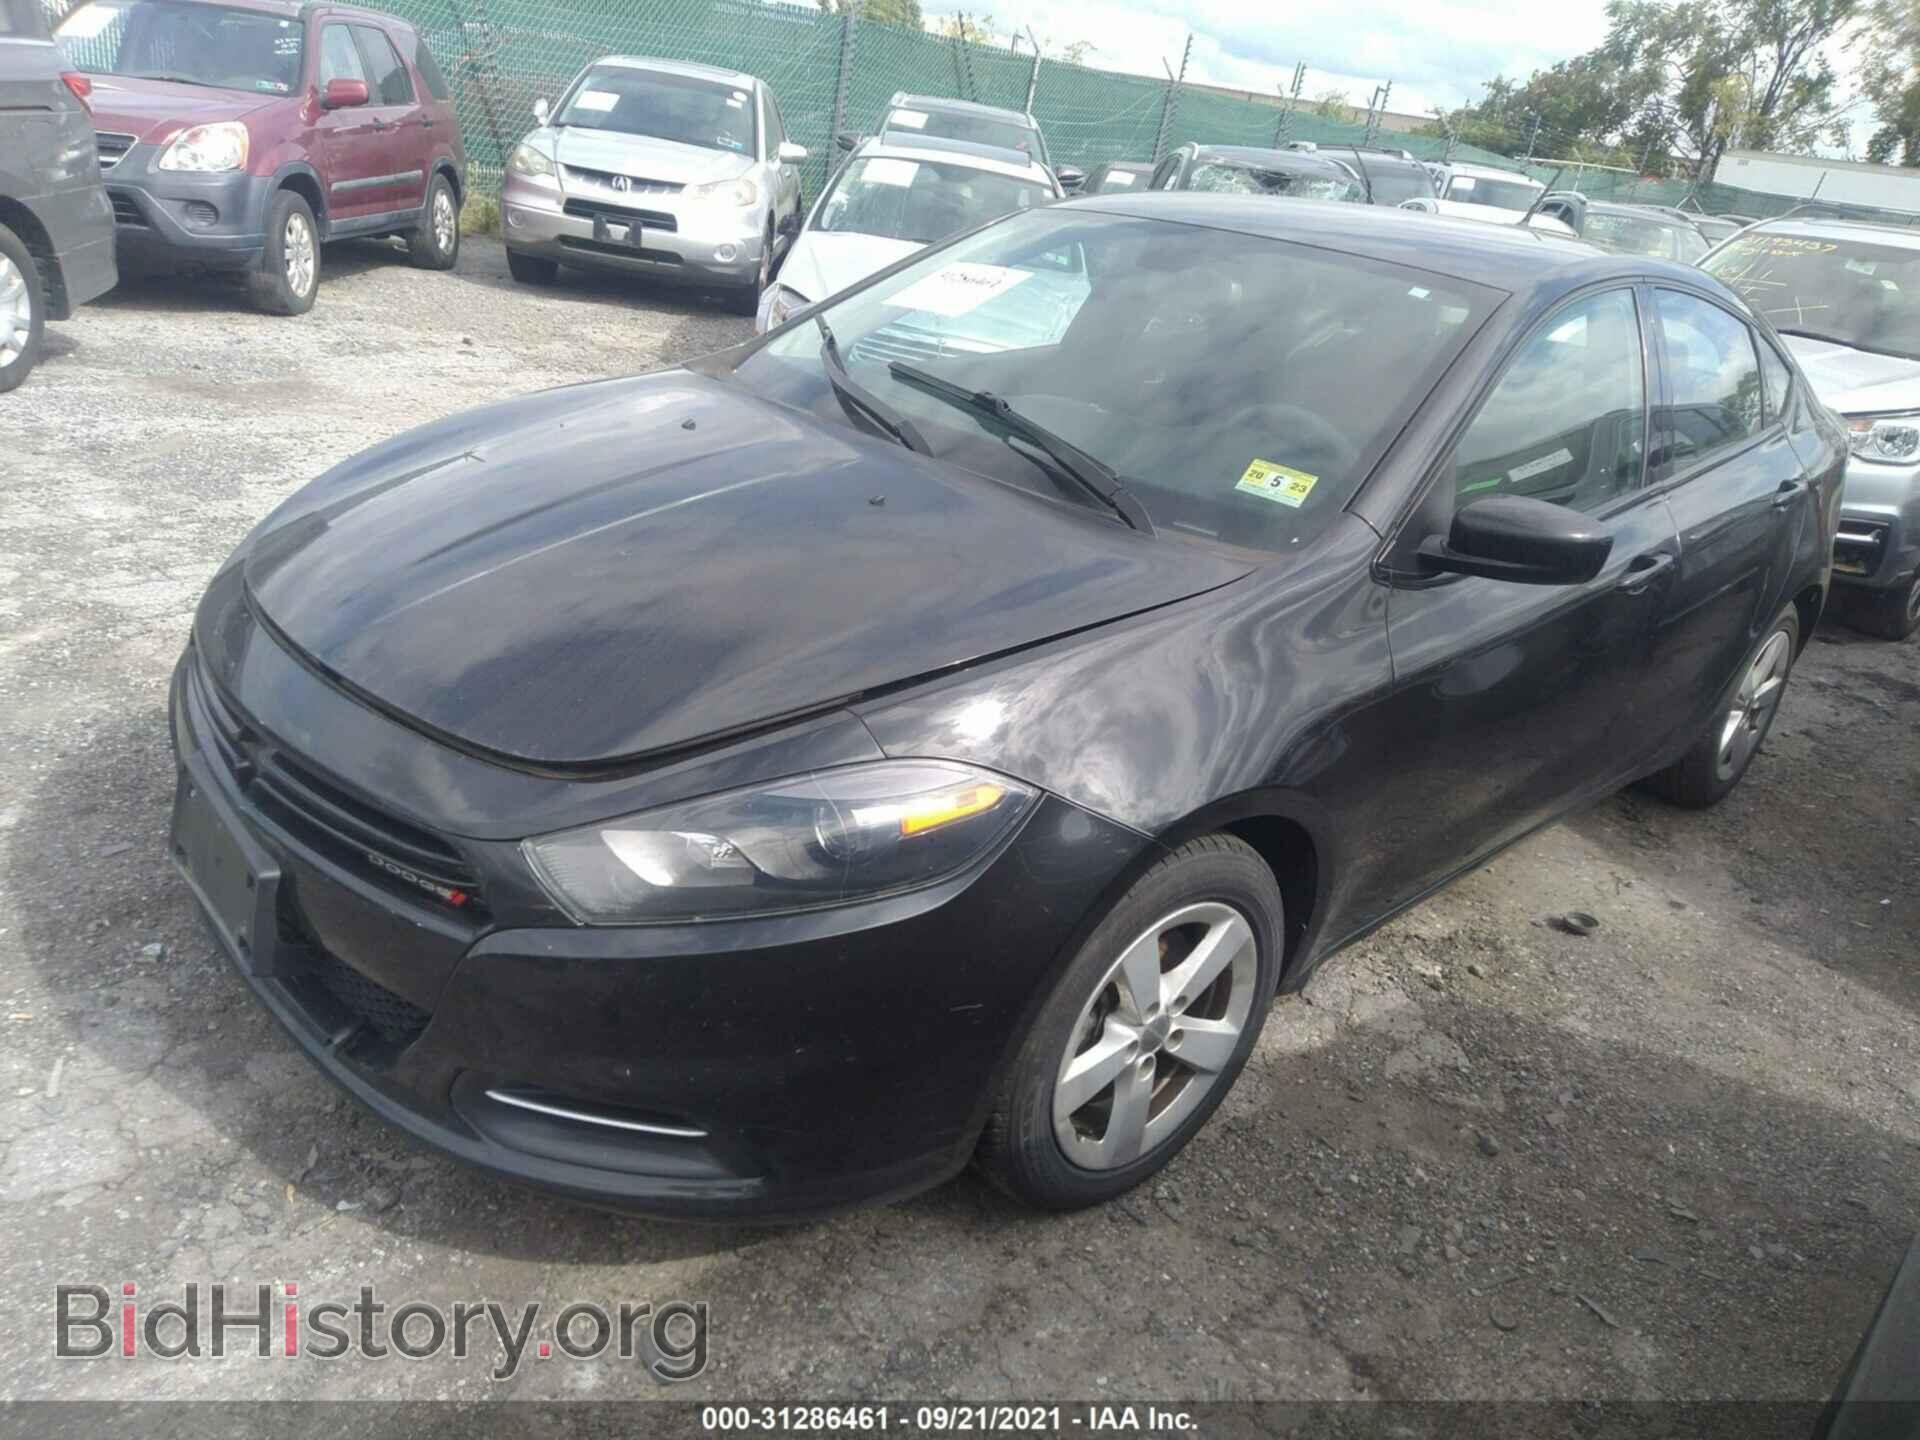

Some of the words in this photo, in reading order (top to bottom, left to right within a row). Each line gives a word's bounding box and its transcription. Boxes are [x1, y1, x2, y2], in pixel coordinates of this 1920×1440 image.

[1248, 469, 1264, 479] 20
[1270, 475, 1284, 487] 5
[1289, 482, 1307, 493] 23
